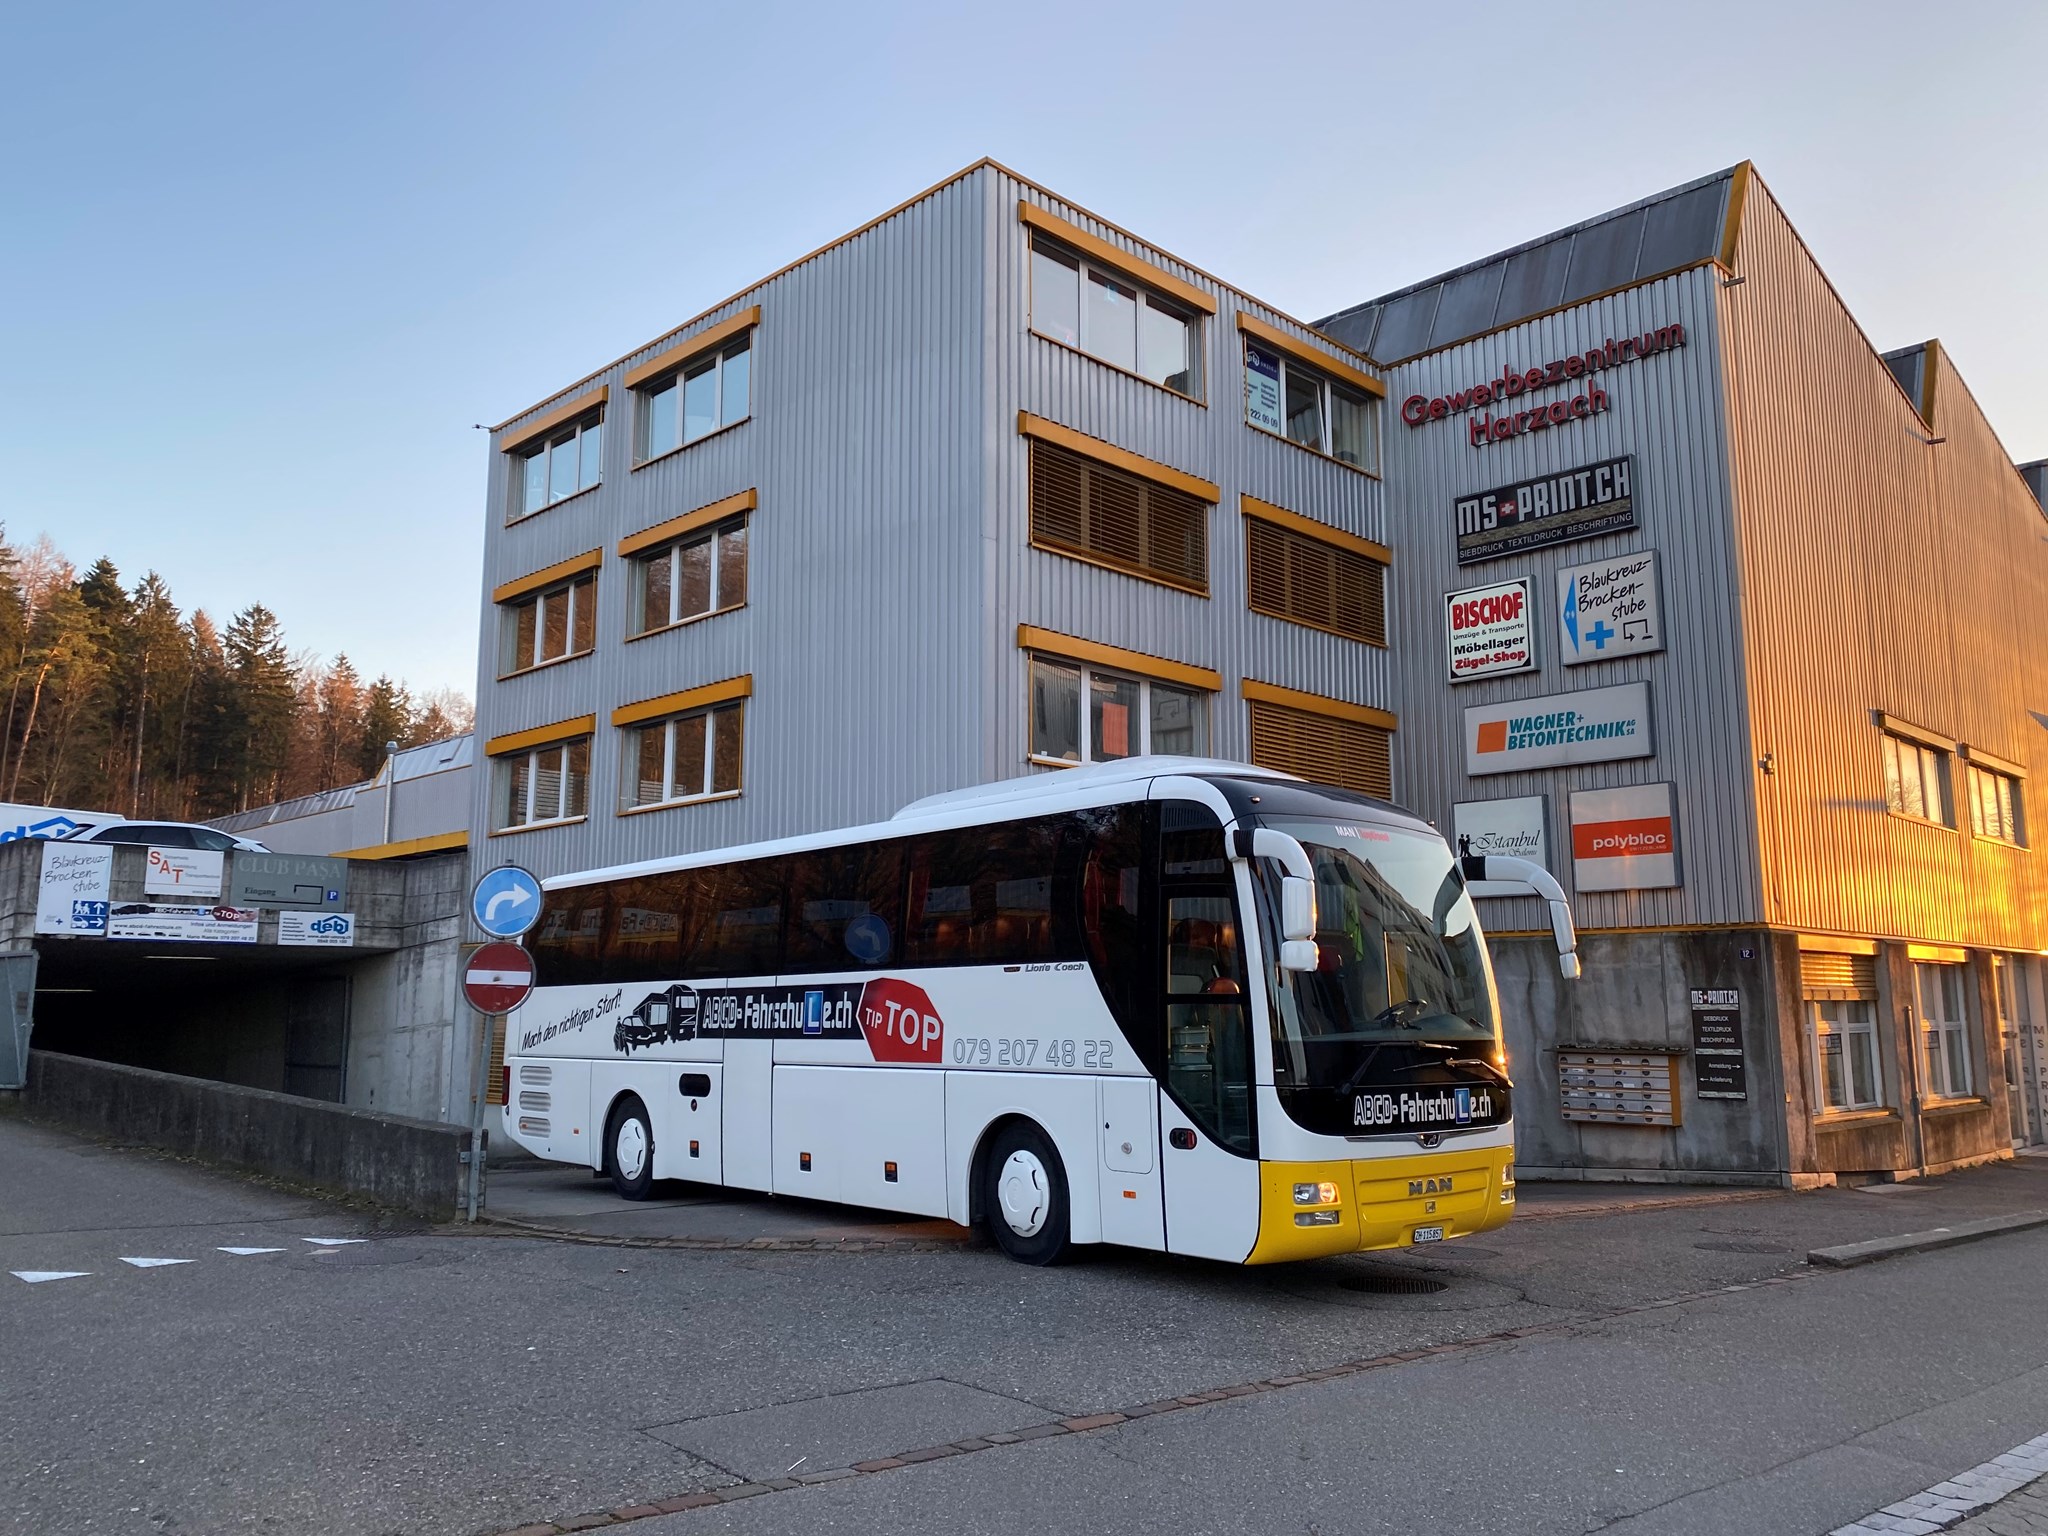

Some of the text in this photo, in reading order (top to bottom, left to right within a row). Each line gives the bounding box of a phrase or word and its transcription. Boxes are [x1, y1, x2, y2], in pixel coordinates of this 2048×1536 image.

[1401, 323, 1687, 426] Gewerbezentrum
[1469, 379, 1609, 447] Harzach
[1459, 512, 1632, 559] SIEBDRUCK TEXTILDRUCK BESCHRIFTUNG
[1579, 559, 1652, 594] Blaukreuz-
[1578, 583, 1644, 613] Brocken-
[1452, 591, 1524, 631] BISCHOF
[1611, 597, 1647, 622] stube
[1453, 631, 1480, 641] Umzüge
[1488, 622, 1525, 634] Transporte
[1454, 636, 1526, 656] Möbellager
[1455, 650, 1526, 670] Zügel-Shop
[1507, 719, 1636, 751] BETONTECHNIK AG
[1626, 728, 1635, 736] SA
[1334, 825, 1356, 838] MAN
[1474, 829, 1541, 850] Istanbul
[1592, 832, 1666, 851] polybloc
[239, 856, 290, 875] CLUB
[44, 868, 99, 884] Brocken-
[72, 880, 101, 894] stube
[244, 886, 277, 897] Eingang
[329, 891, 337, 900] P
[220, 909, 240, 920] TOP
[1742, 949, 1751, 958] 12
[1053, 962, 1085, 972] Coach
[521, 987, 623, 1051] Mach den richtigen Start!
[865, 1006, 883, 1029] TIP
[884, 999, 941, 1052] TOP
[952, 1037, 1114, 1069] 079 207 48 22
[1708, 1062, 1732, 1070] Anmeldung
[1408, 1175, 1453, 1196] MAN
